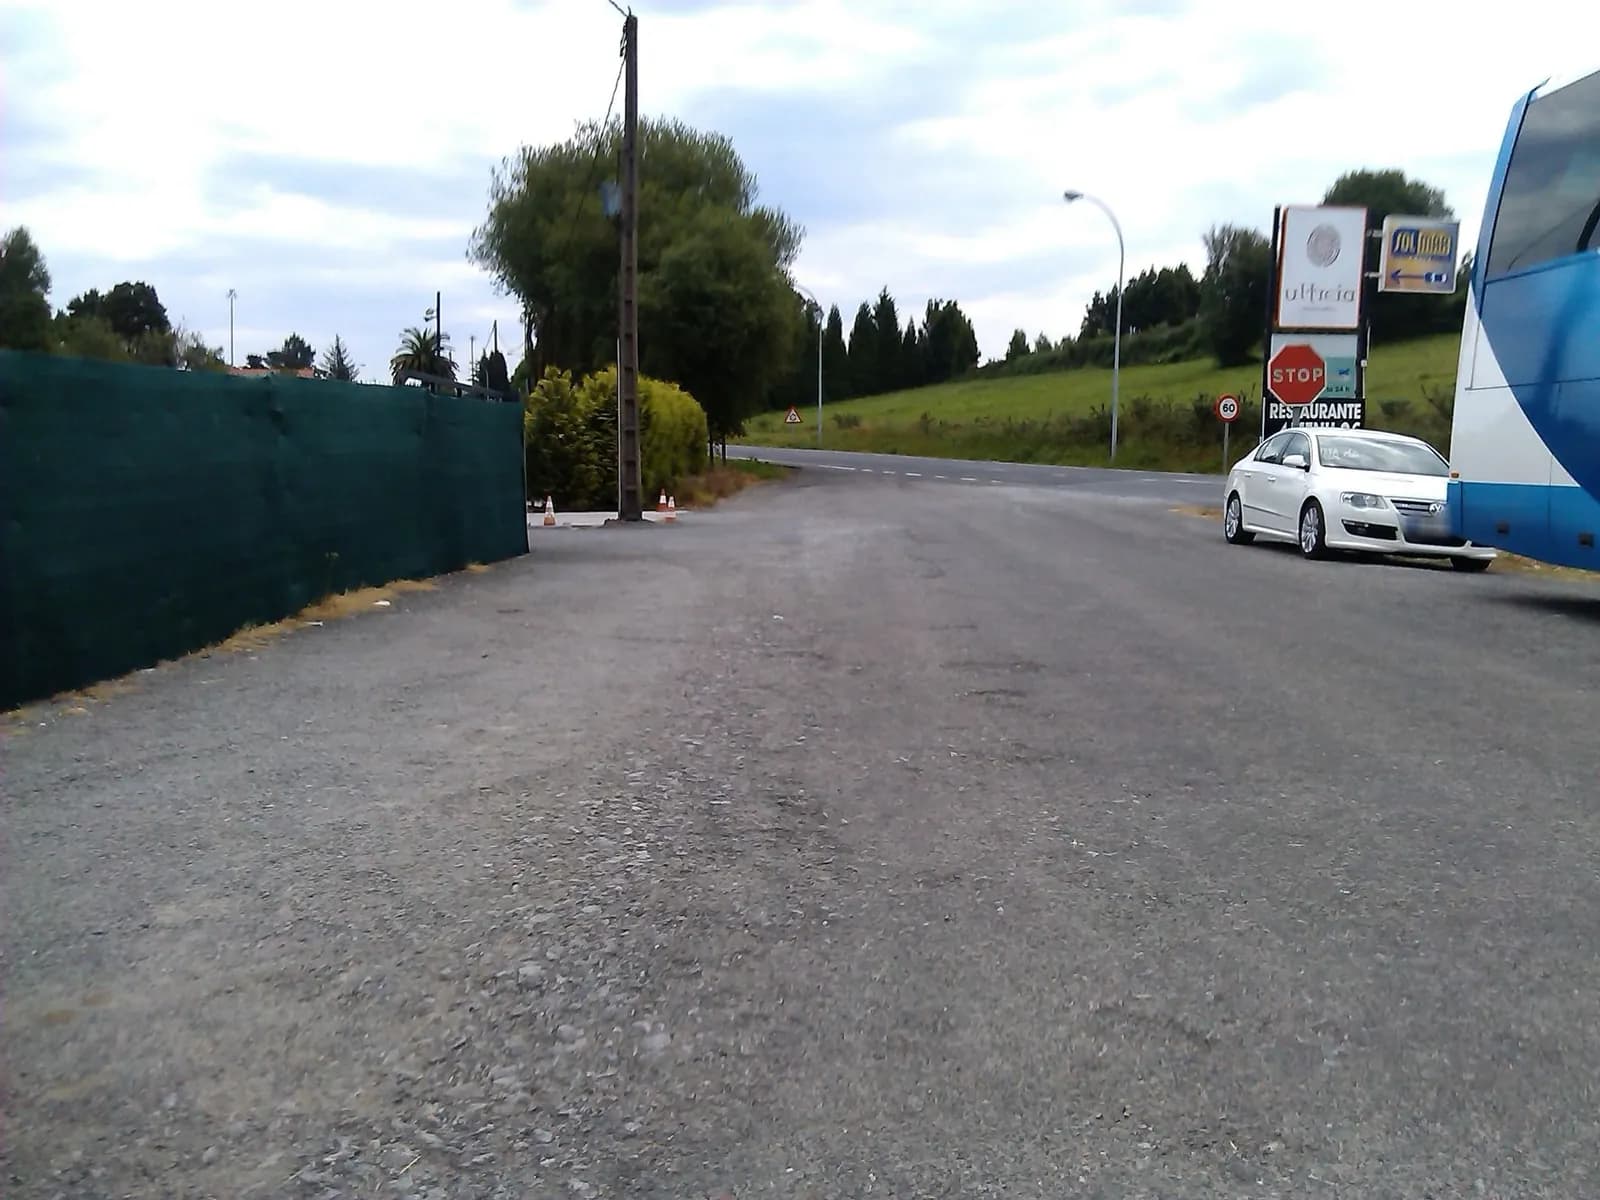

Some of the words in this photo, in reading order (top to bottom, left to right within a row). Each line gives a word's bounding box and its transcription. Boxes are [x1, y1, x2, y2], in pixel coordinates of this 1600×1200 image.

[1273, 368, 1323, 383] STOP
[1222, 403, 1235, 412] 60
[1269, 403, 1362, 419] RESAURANTE
